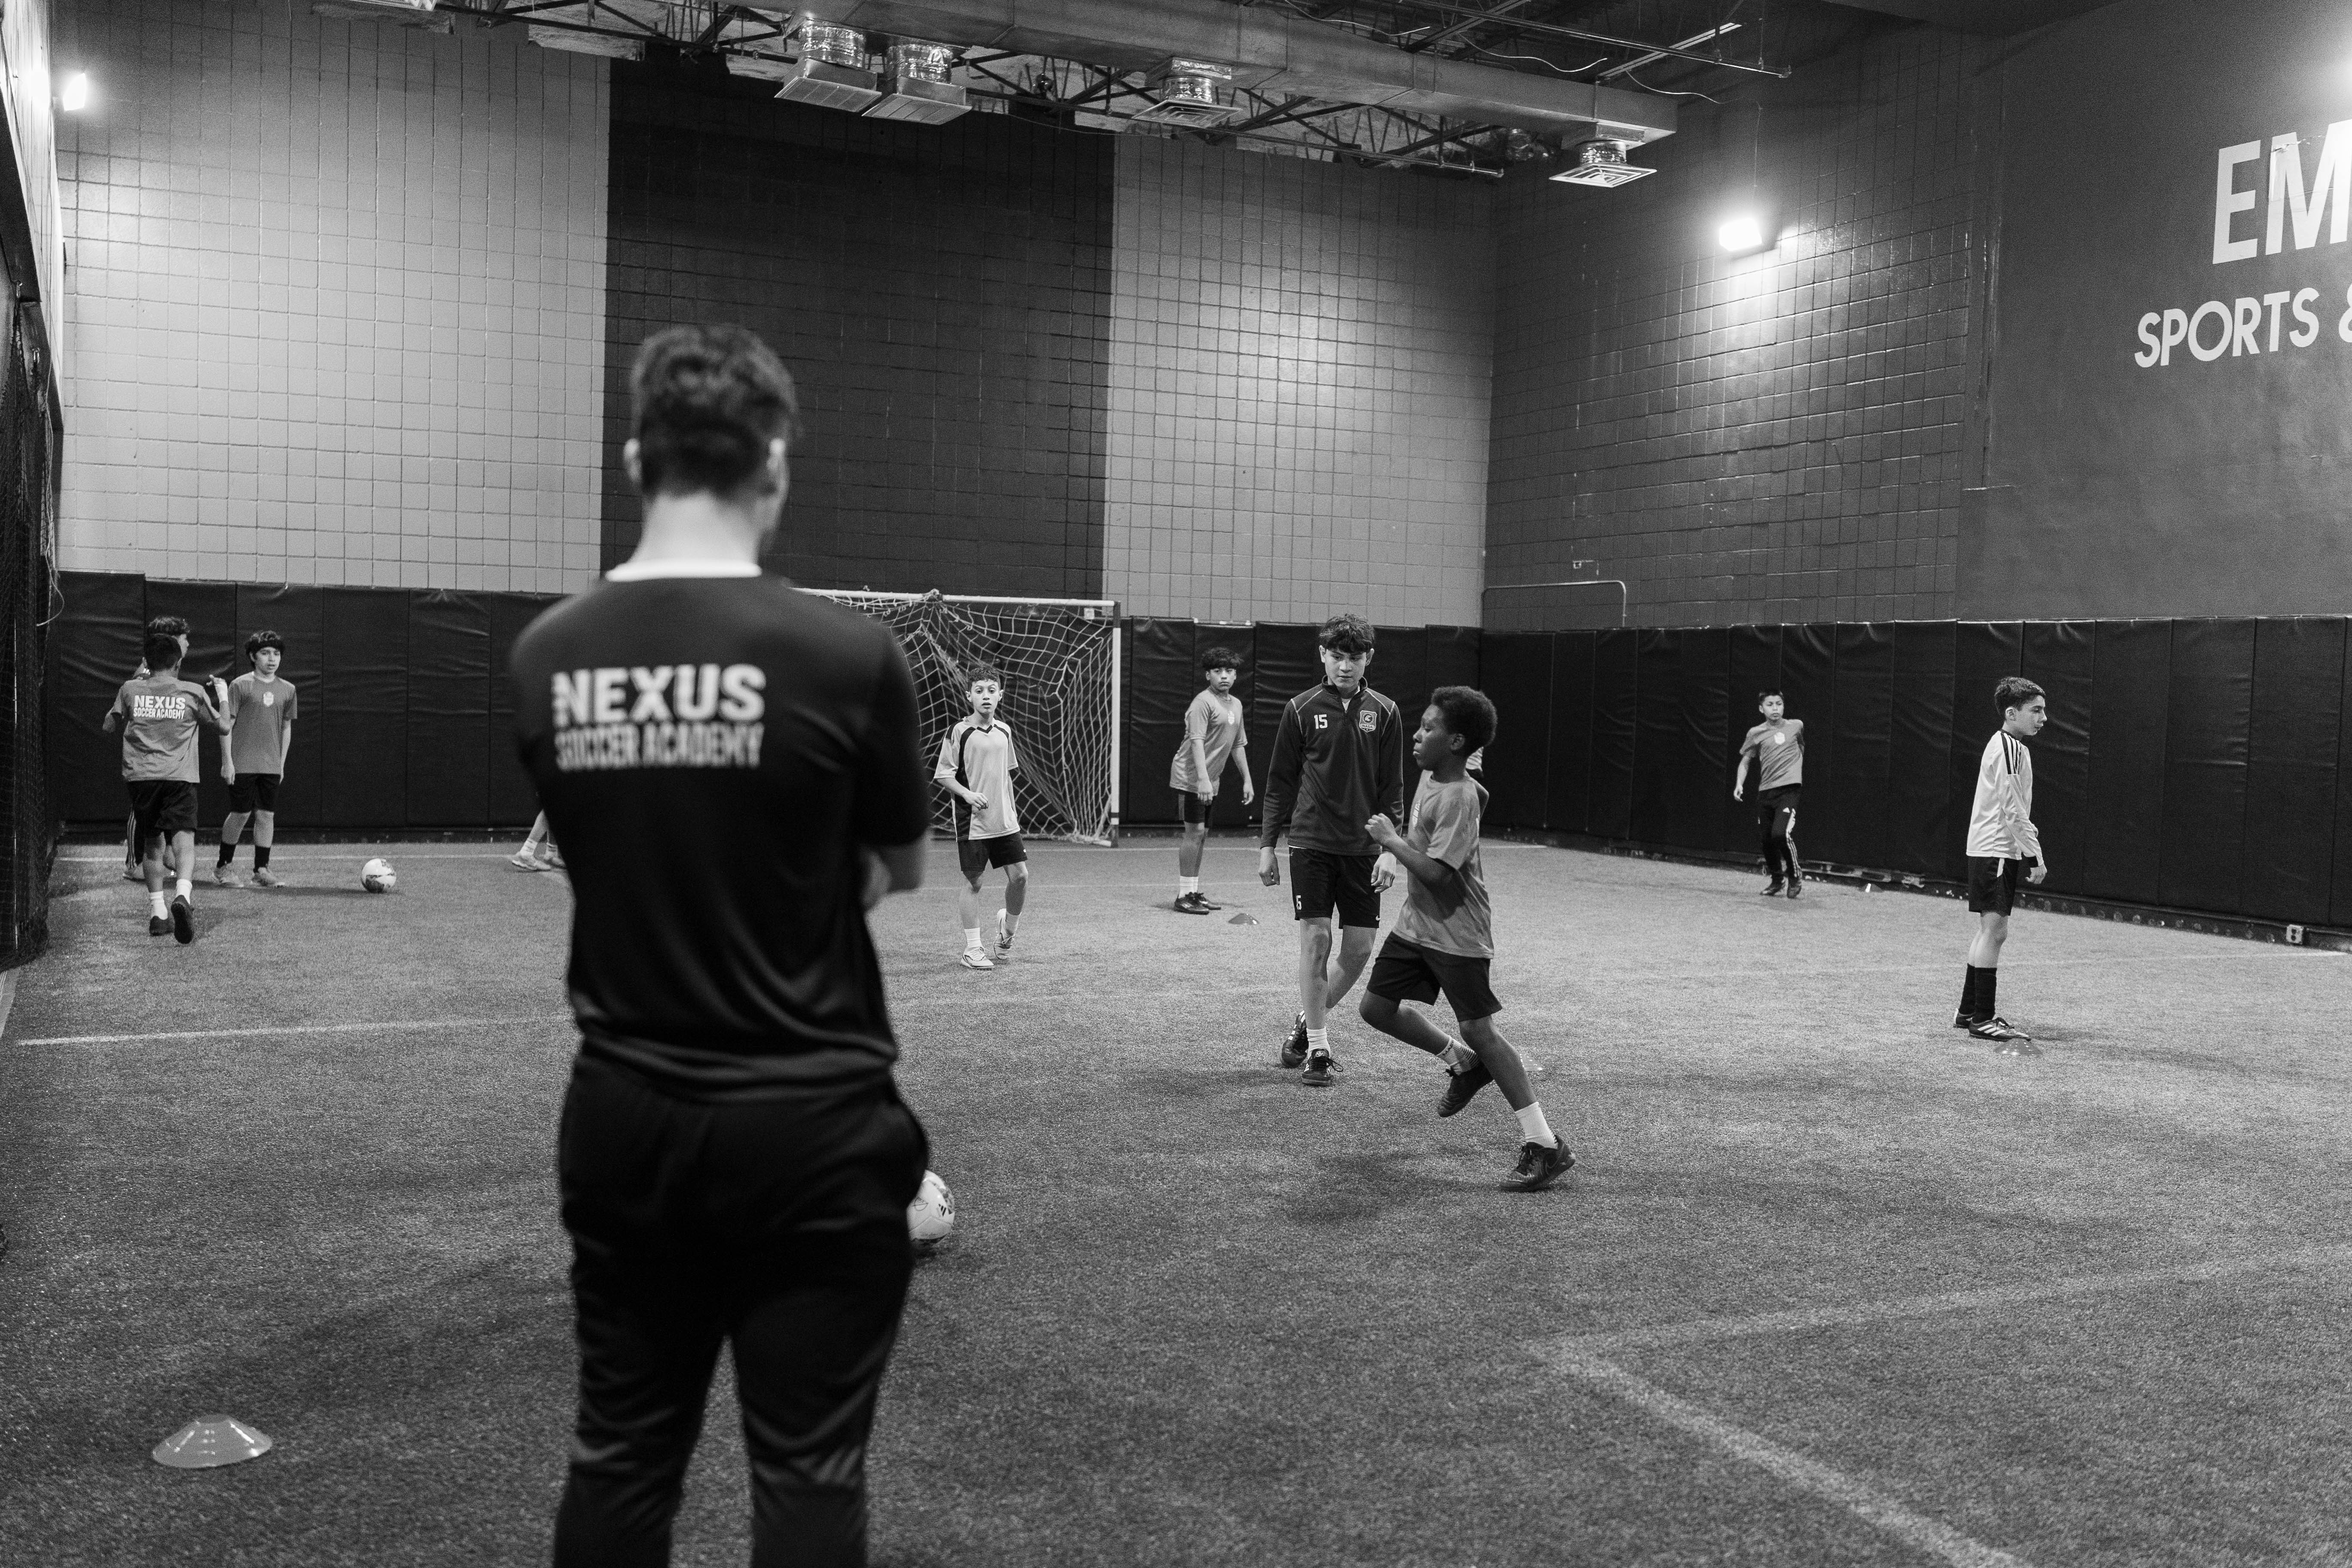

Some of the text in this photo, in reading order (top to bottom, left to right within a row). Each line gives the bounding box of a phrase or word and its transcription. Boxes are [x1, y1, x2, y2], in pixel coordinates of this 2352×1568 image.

[2135, 287, 2319, 368] SPORTS
[134, 695, 186, 710] NEXUS
[552, 664, 766, 729] NEXUS
[133, 707, 185, 719] SOCCER ACADEMY
[1314, 714, 1328, 729] 15
[555, 721, 765, 771] SOCCER ACADEMY
